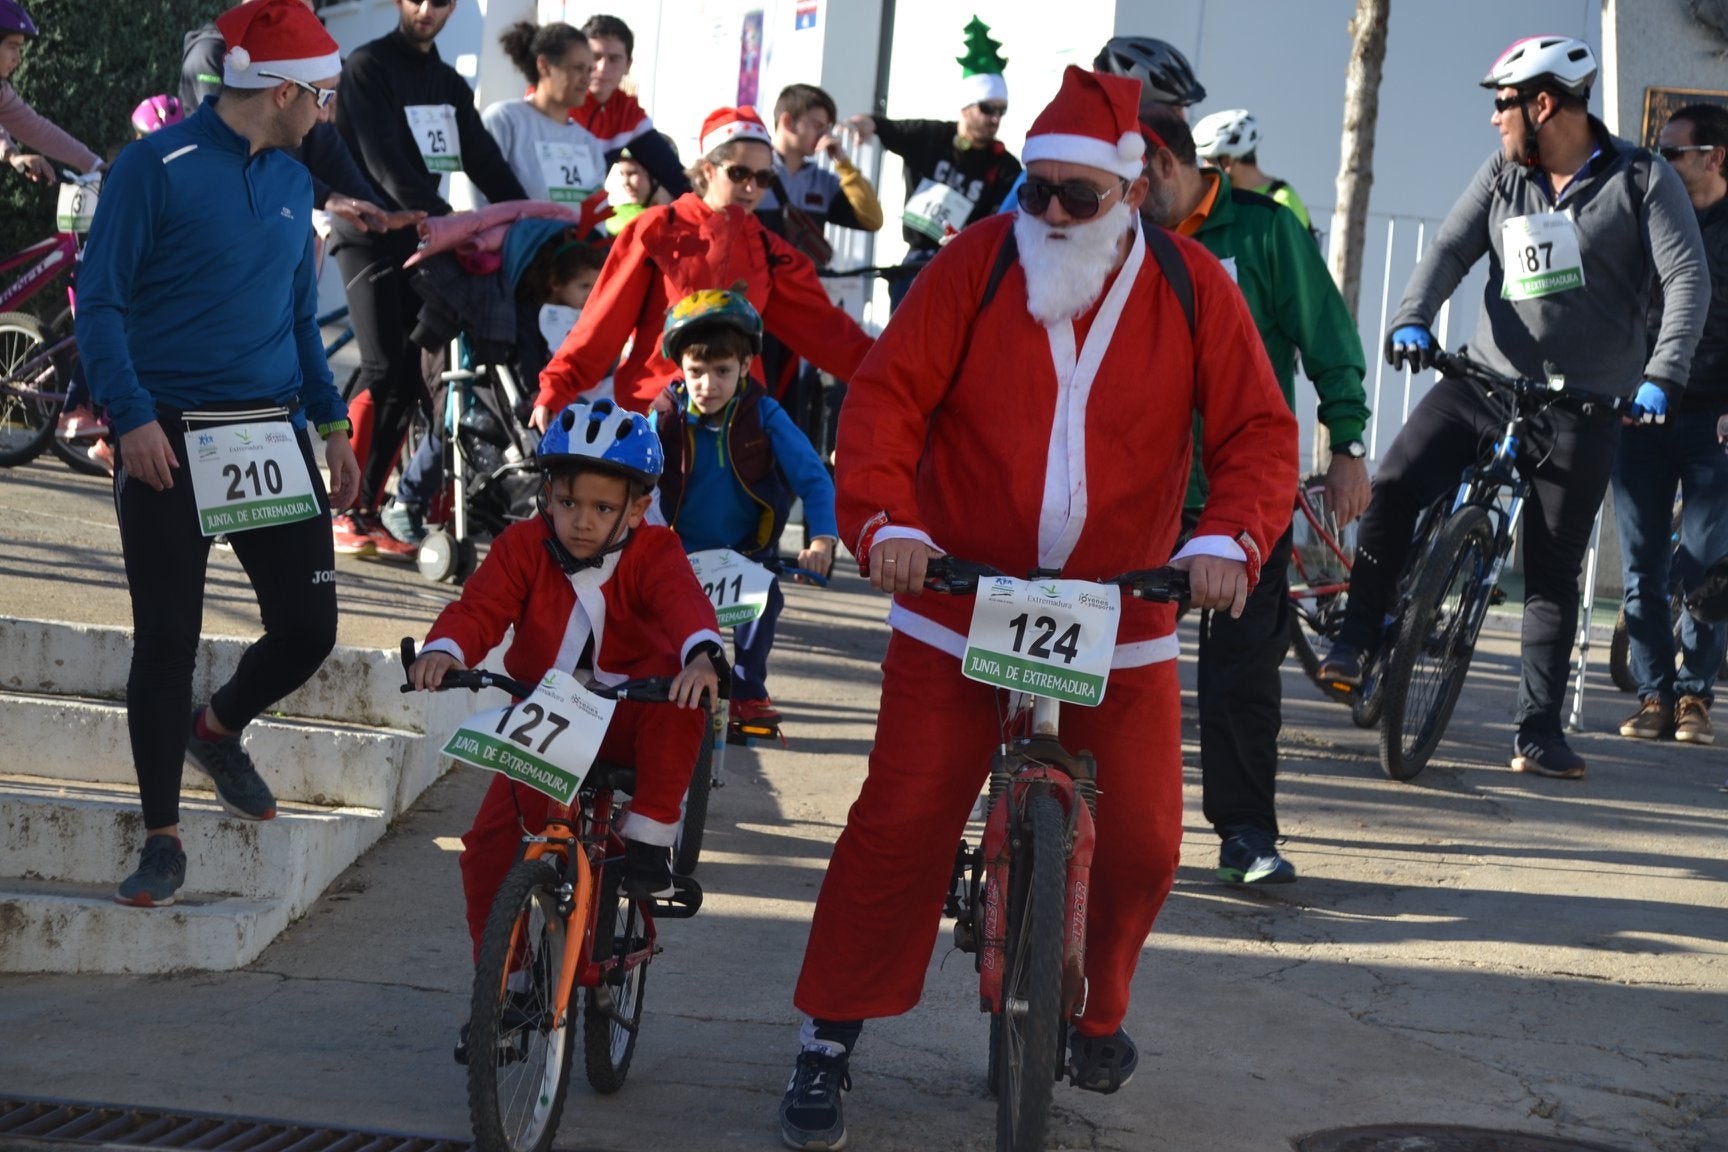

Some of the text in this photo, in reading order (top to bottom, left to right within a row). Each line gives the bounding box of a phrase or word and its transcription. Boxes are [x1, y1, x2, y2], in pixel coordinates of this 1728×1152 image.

[427, 130, 447, 153] 25
[561, 164, 583, 186] 24
[1518, 241, 1553, 273] 187
[222, 459, 283, 501] 210
[206, 502, 313, 529] JUNTA DE EXTREMADURA
[1027, 595, 1073, 610] Extremadura
[1009, 613, 1082, 664] 124
[970, 656, 1096, 699] JUNTA DE EXTREMADURA
[495, 703, 571, 755] 127
[452, 735, 569, 796] JUNTA DE EXTREMADURA
